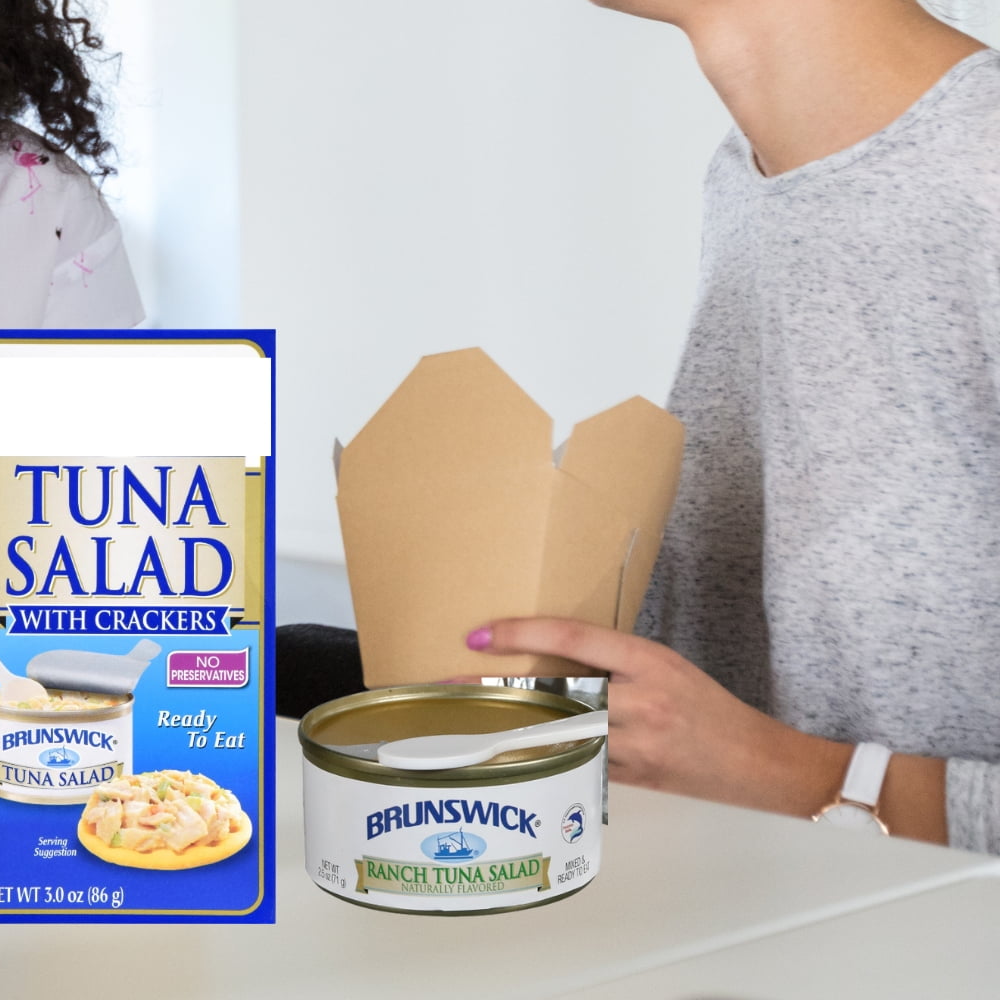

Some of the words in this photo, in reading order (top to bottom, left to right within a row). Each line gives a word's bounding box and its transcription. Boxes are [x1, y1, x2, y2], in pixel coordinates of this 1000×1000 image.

[14, 464, 229, 528] TUNA
[5, 534, 235, 598] SALAD
[19, 609, 87, 631] WITH
[94, 609, 217, 631] CRACKERS
[195, 655, 221, 669] NO
[170, 669, 246, 682] PRESERVATIVES
[157, 710, 218, 732] Ready
[2, 727, 114, 752] BRUNSWICK
[187, 731, 207, 749] To
[214, 732, 246, 750] Eat
[2, 764, 55, 787] TUNA
[59, 765, 115, 787] SALAD
[366, 799, 538, 841] BRUNSWICK
[33, 846, 77, 859] Suggestion
[37, 836, 69, 848] Serving
[367, 858, 428, 885] RANCH
[432, 865, 484, 884] TUNA
[490, 858, 540, 882] SALAD
[16, 886, 40, 903] WT
[44, 886, 64, 903] 3.0
[67, 889, 84, 903] oz
[87, 886, 108, 906] (86
[111, 886, 124, 907] g)
[401, 882, 455, 895] NATURALLY
[456, 881, 505, 894] FLAVORED
